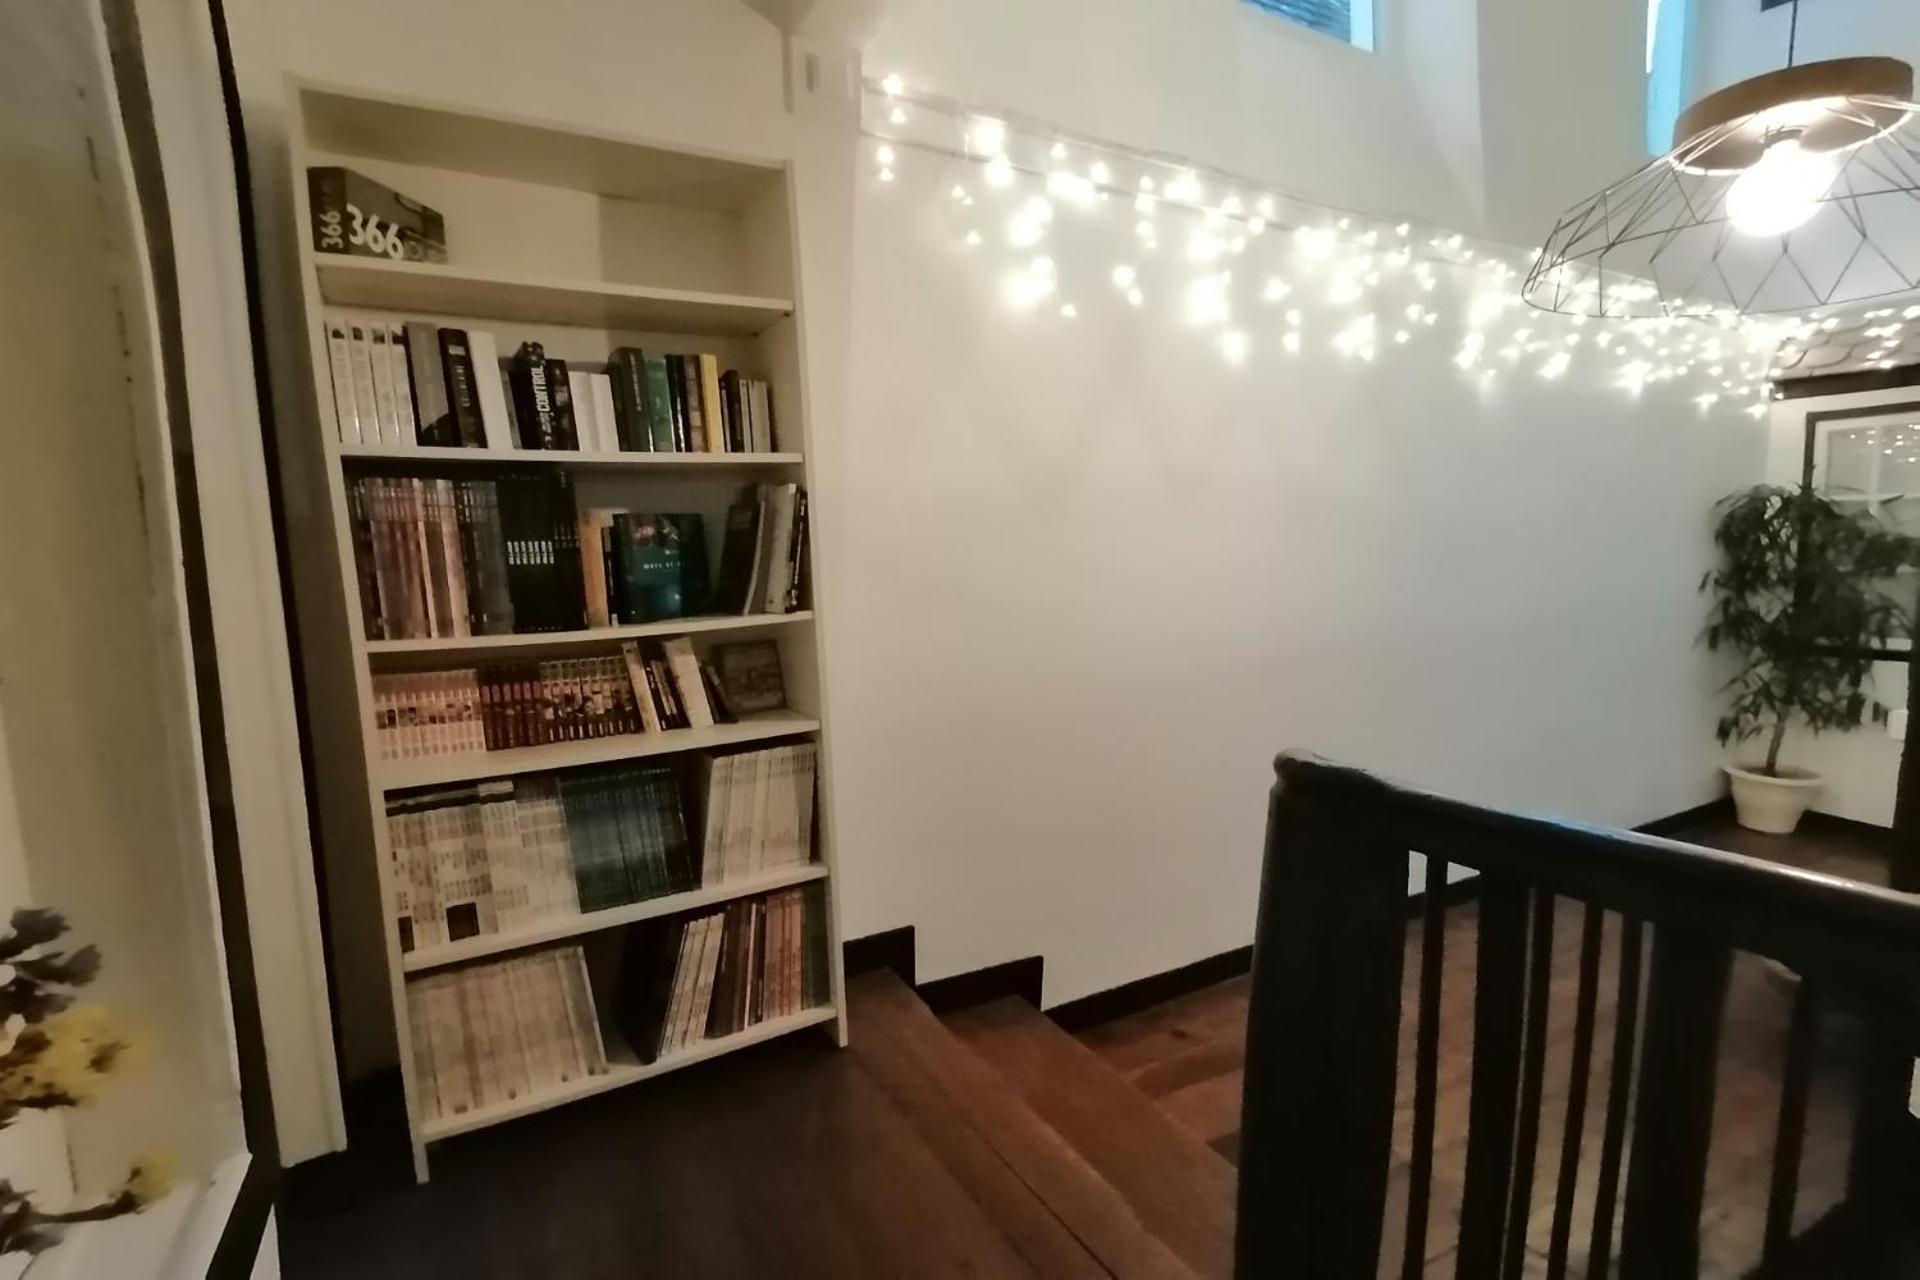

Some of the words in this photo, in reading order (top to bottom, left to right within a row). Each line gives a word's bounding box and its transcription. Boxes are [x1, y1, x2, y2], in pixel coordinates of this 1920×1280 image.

[319, 210, 344, 249] 366
[346, 203, 404, 260] 366
[530, 364, 550, 412] CONTROL
